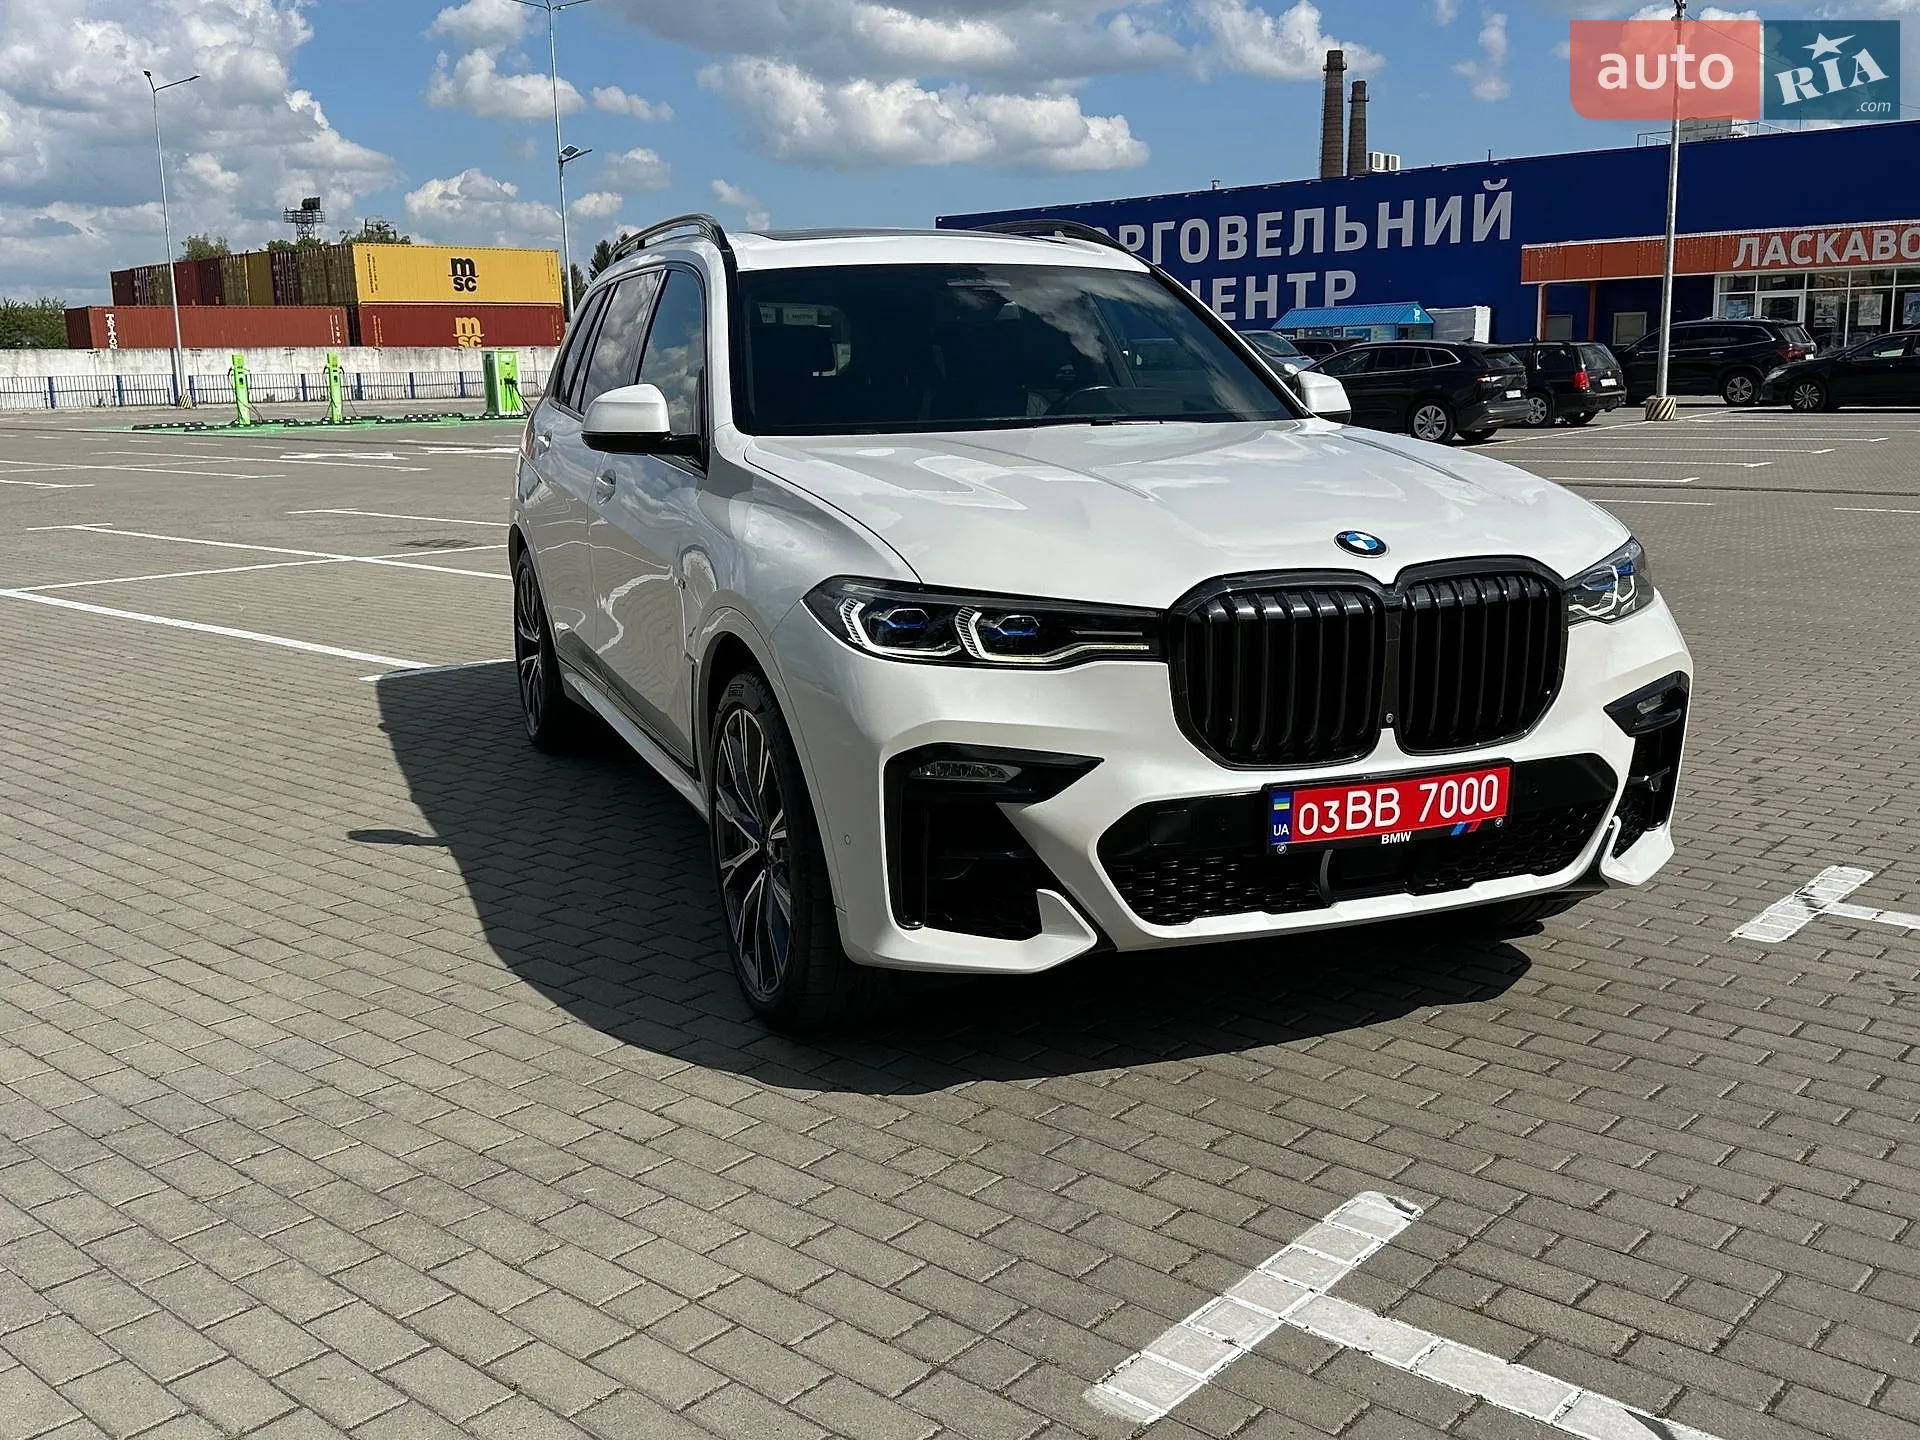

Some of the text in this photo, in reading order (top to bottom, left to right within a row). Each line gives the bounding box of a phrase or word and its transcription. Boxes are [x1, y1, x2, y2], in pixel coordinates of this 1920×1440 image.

[1094, 179, 1512, 265] РГОВЕЛЬНИЙ
[1191, 270, 1356, 321] ЕНТР
[1419, 774, 1499, 823] 7000
[1273, 824, 1290, 836] UA
[1381, 831, 1412, 845] BMW
